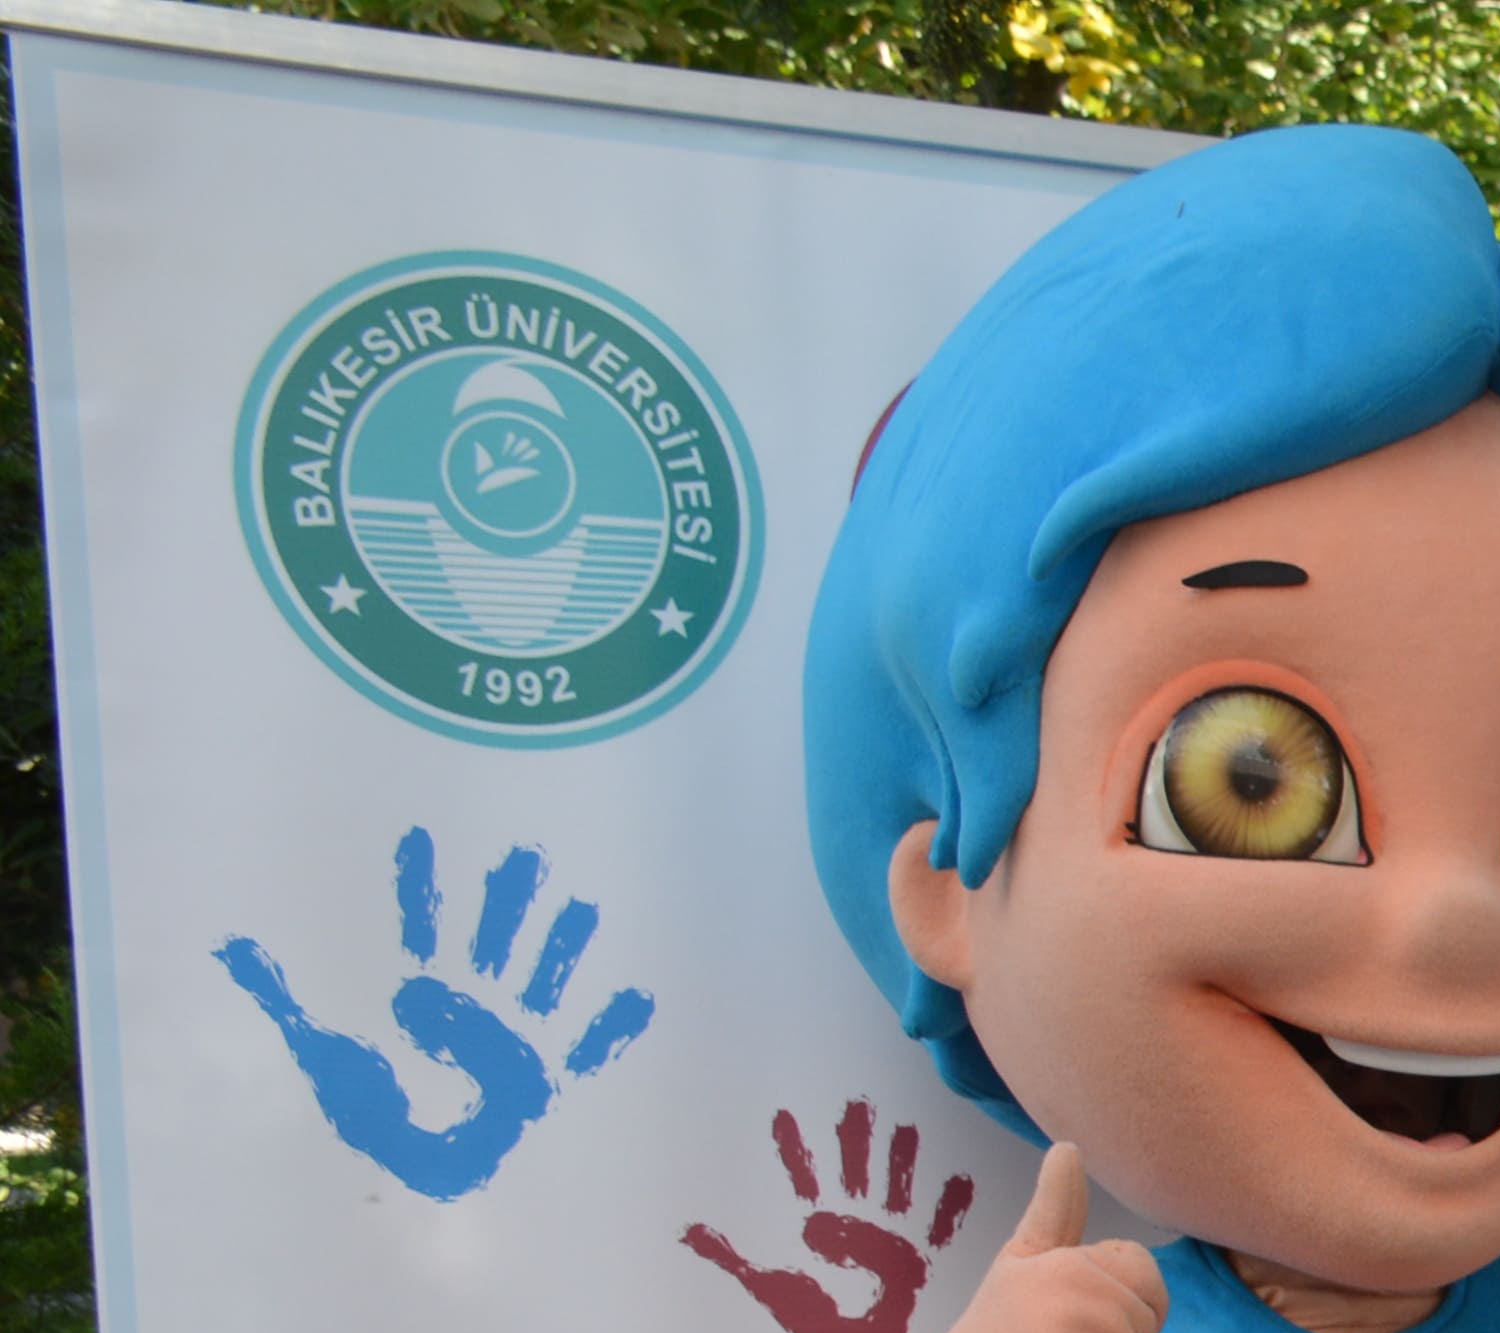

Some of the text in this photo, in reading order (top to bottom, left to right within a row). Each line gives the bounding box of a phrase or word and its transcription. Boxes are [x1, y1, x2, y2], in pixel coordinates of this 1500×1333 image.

[290, 293, 718, 566] BALIKESİR ÜNİVERSİTESİ
[457, 661, 577, 707] 1992
